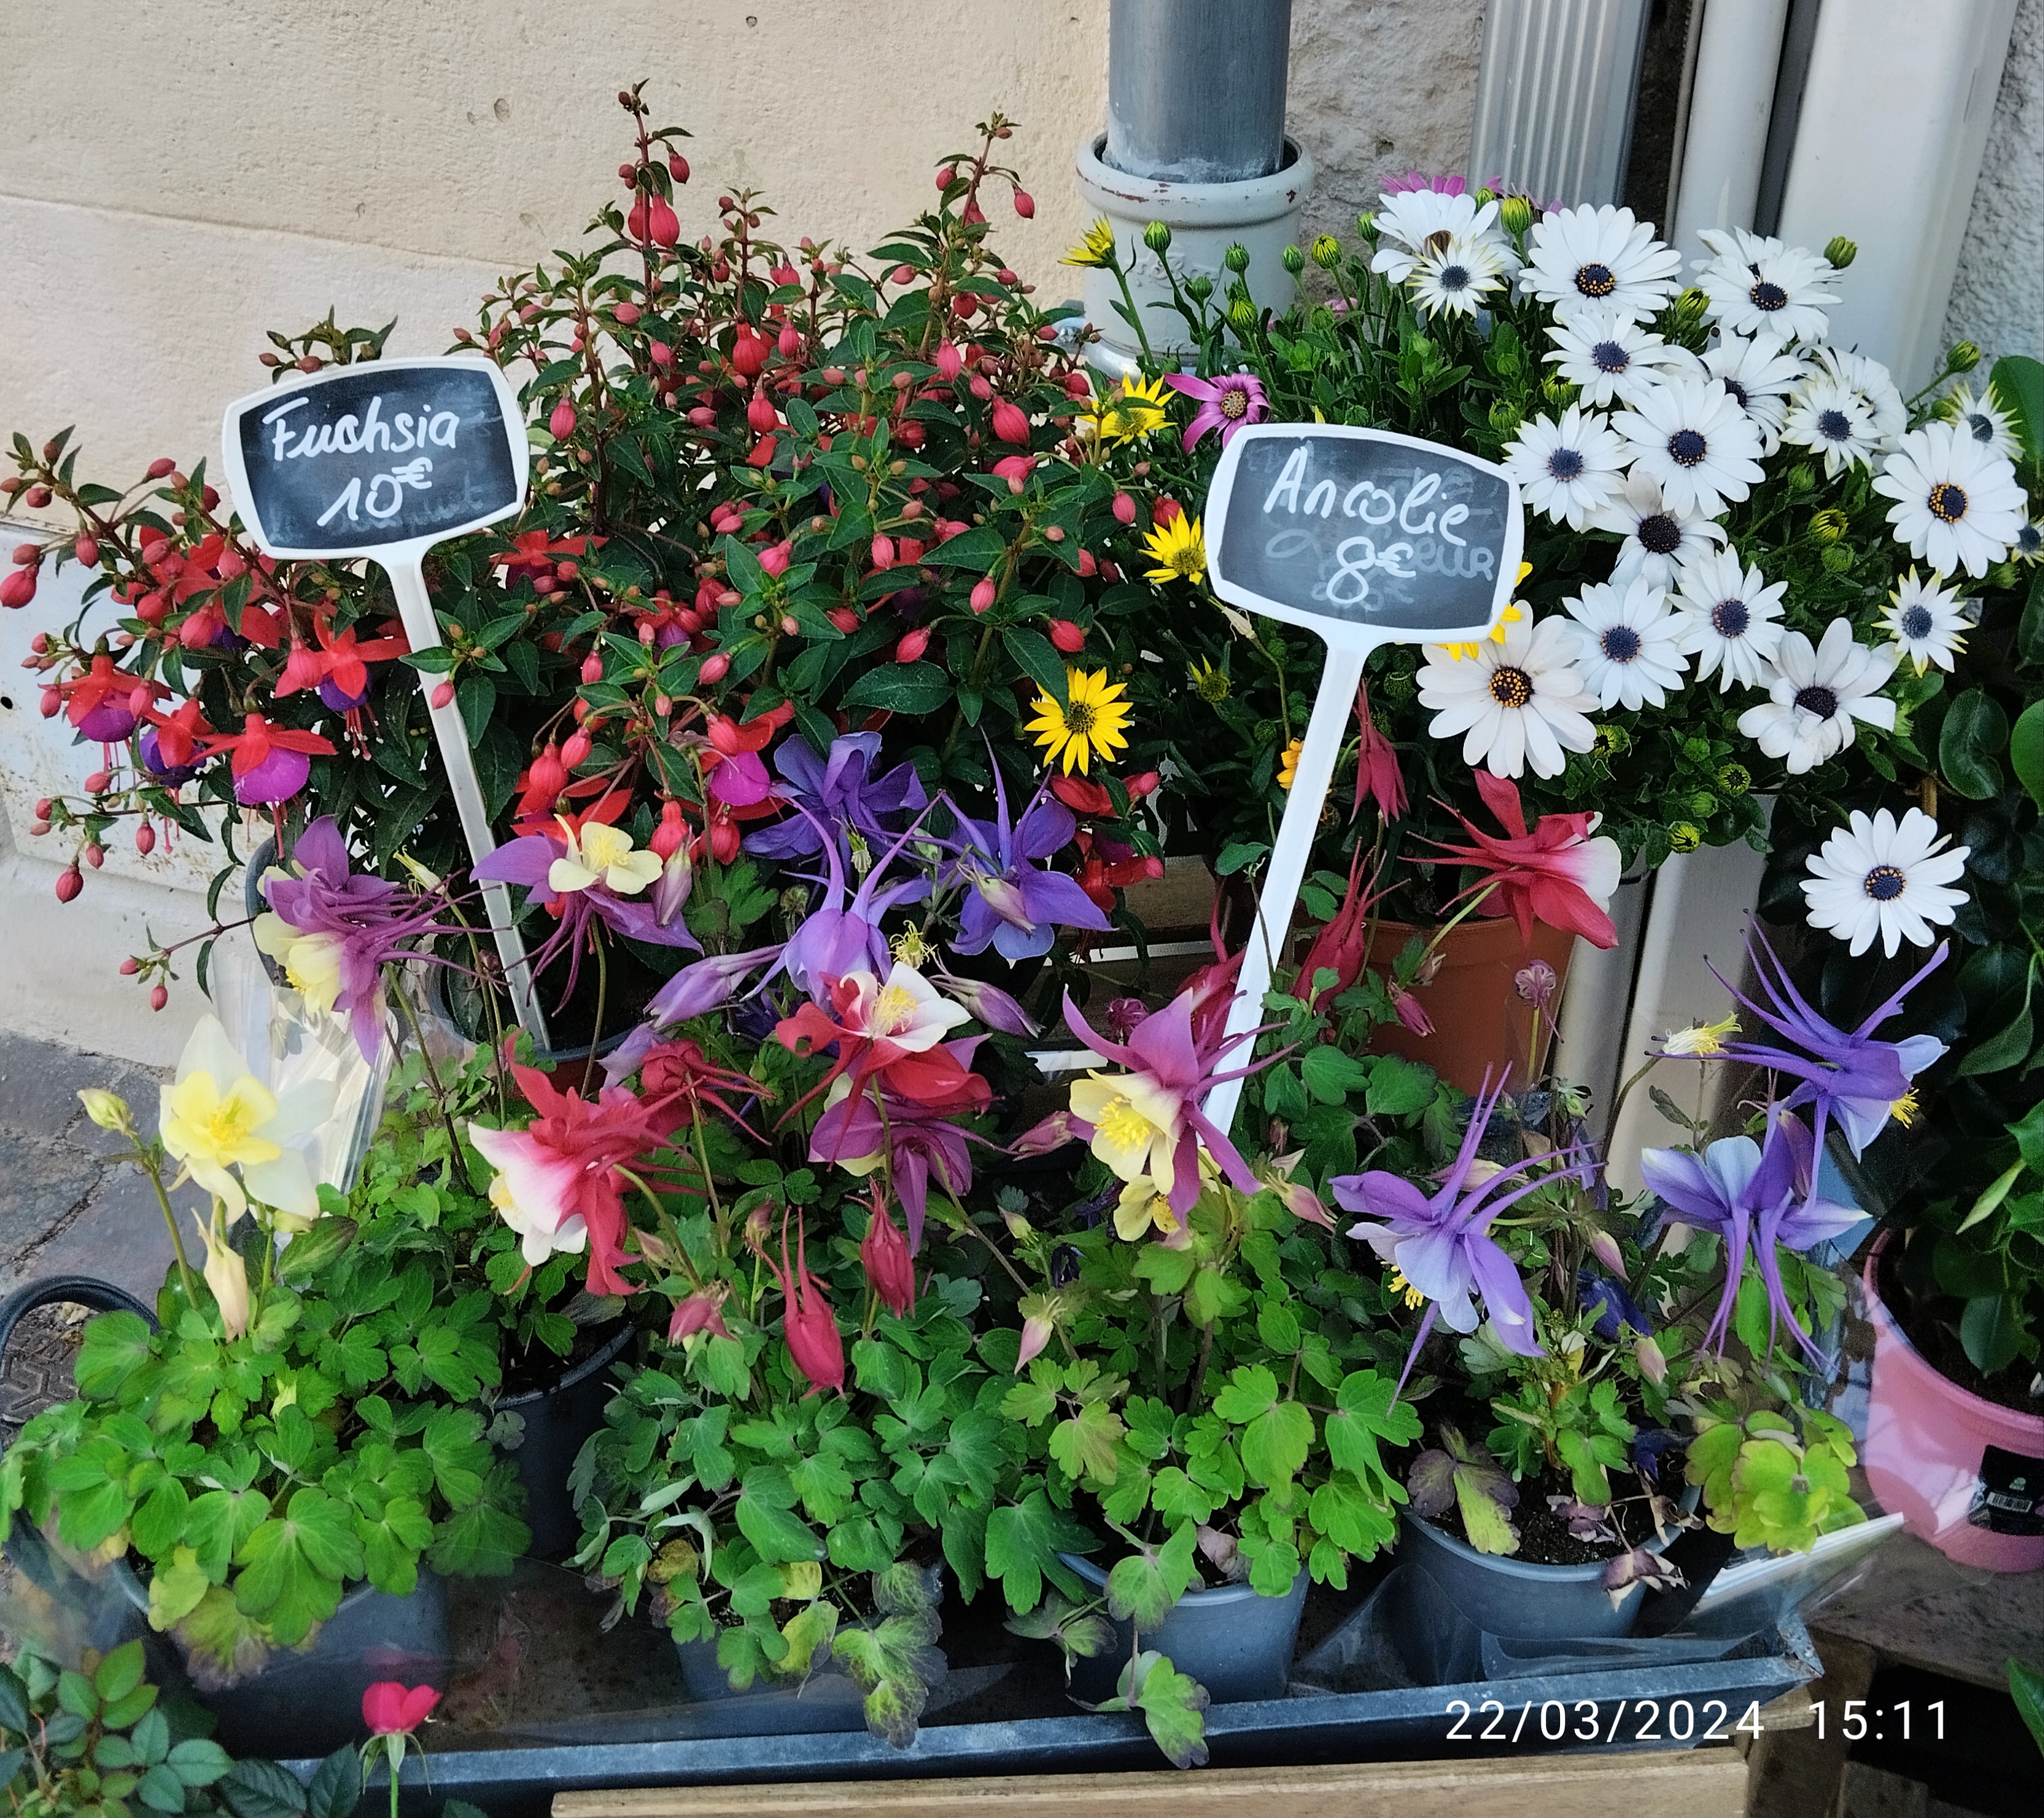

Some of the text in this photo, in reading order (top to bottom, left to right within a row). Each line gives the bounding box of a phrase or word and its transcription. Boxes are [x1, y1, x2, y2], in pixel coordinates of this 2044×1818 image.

[262, 396, 460, 461] Fuchsia
[316, 457, 433, 526] 10€
[1264, 446, 1469, 546] Ancolie
[1326, 536, 1417, 604] 8€
